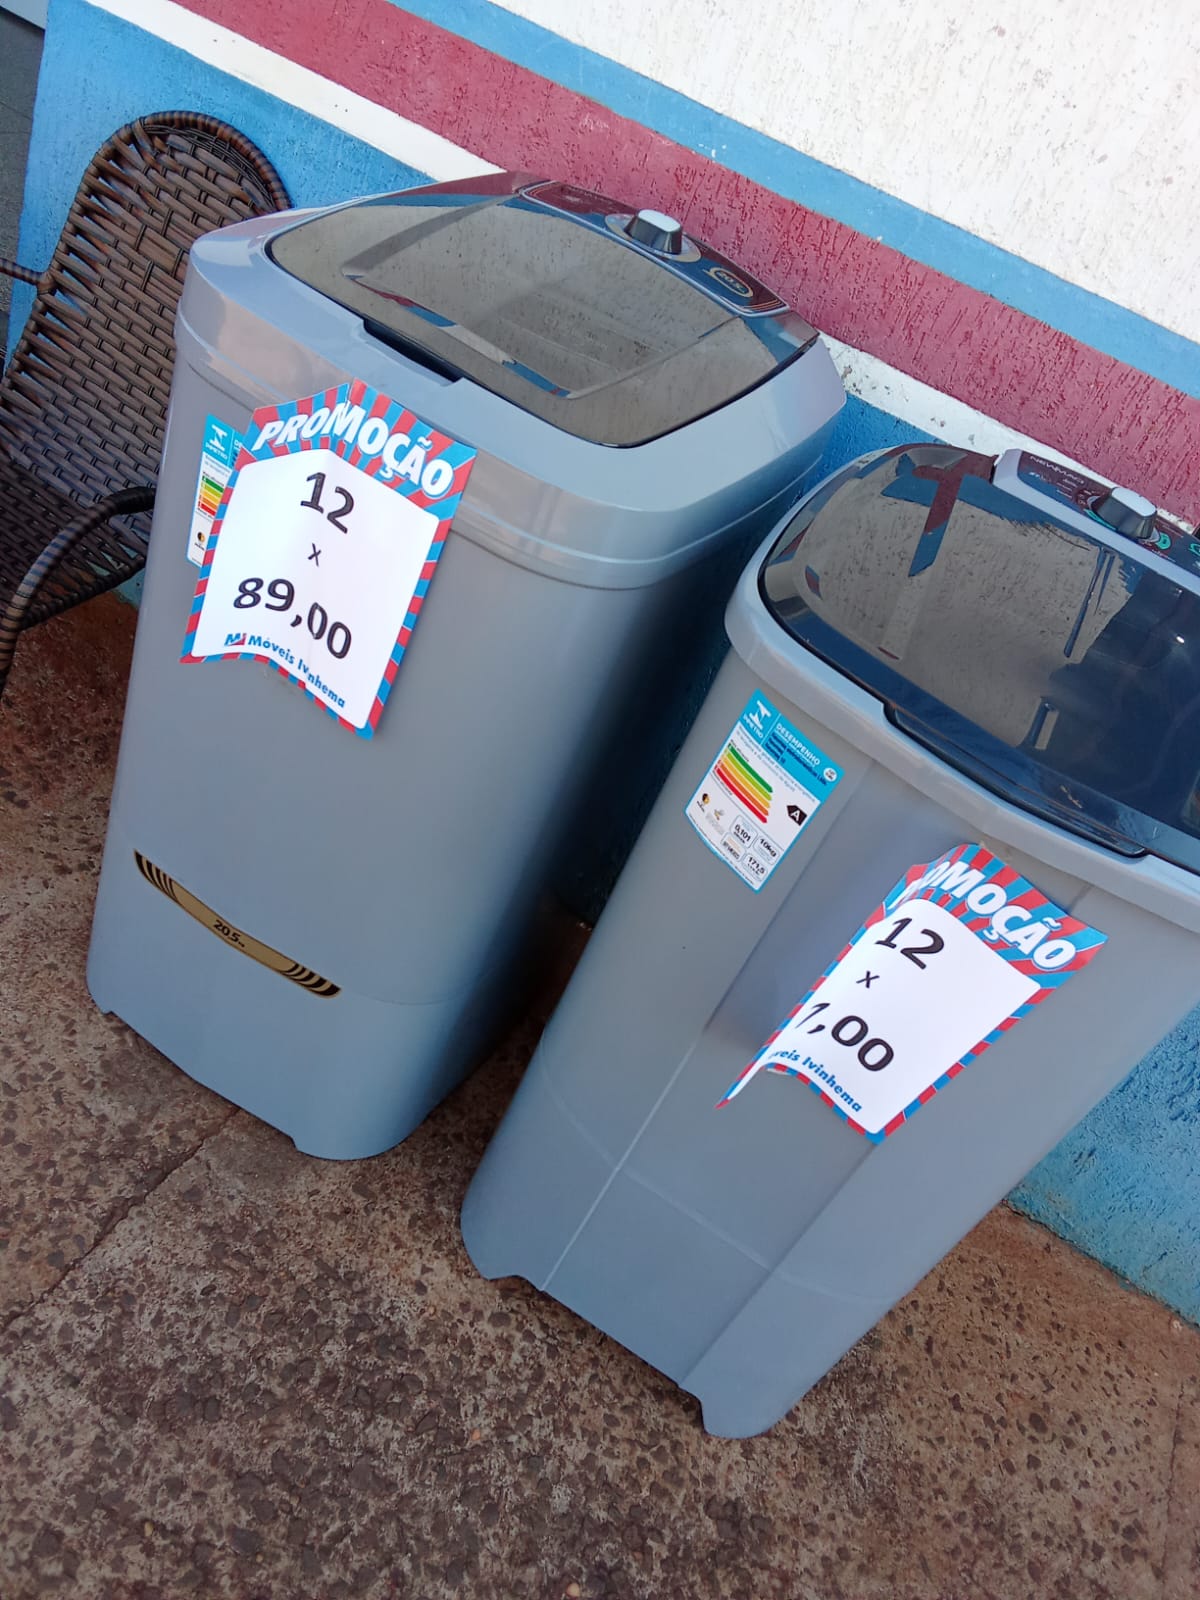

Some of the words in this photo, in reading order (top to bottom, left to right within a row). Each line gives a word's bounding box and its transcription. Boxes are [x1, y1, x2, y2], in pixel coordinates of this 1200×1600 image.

[251, 400, 454, 497] PROMOÇÃO
[300, 472, 355, 534] 12
[233, 577, 352, 659] 89,00
[248, 634, 295, 664] Móveis
[297, 658, 346, 708] Ivnhema
[775, 722, 821, 766] DESEMPENHO
[790, 809, 801, 822] A
[875, 916, 945, 970] 12
[802, 1056, 862, 1112] Ivinhema
